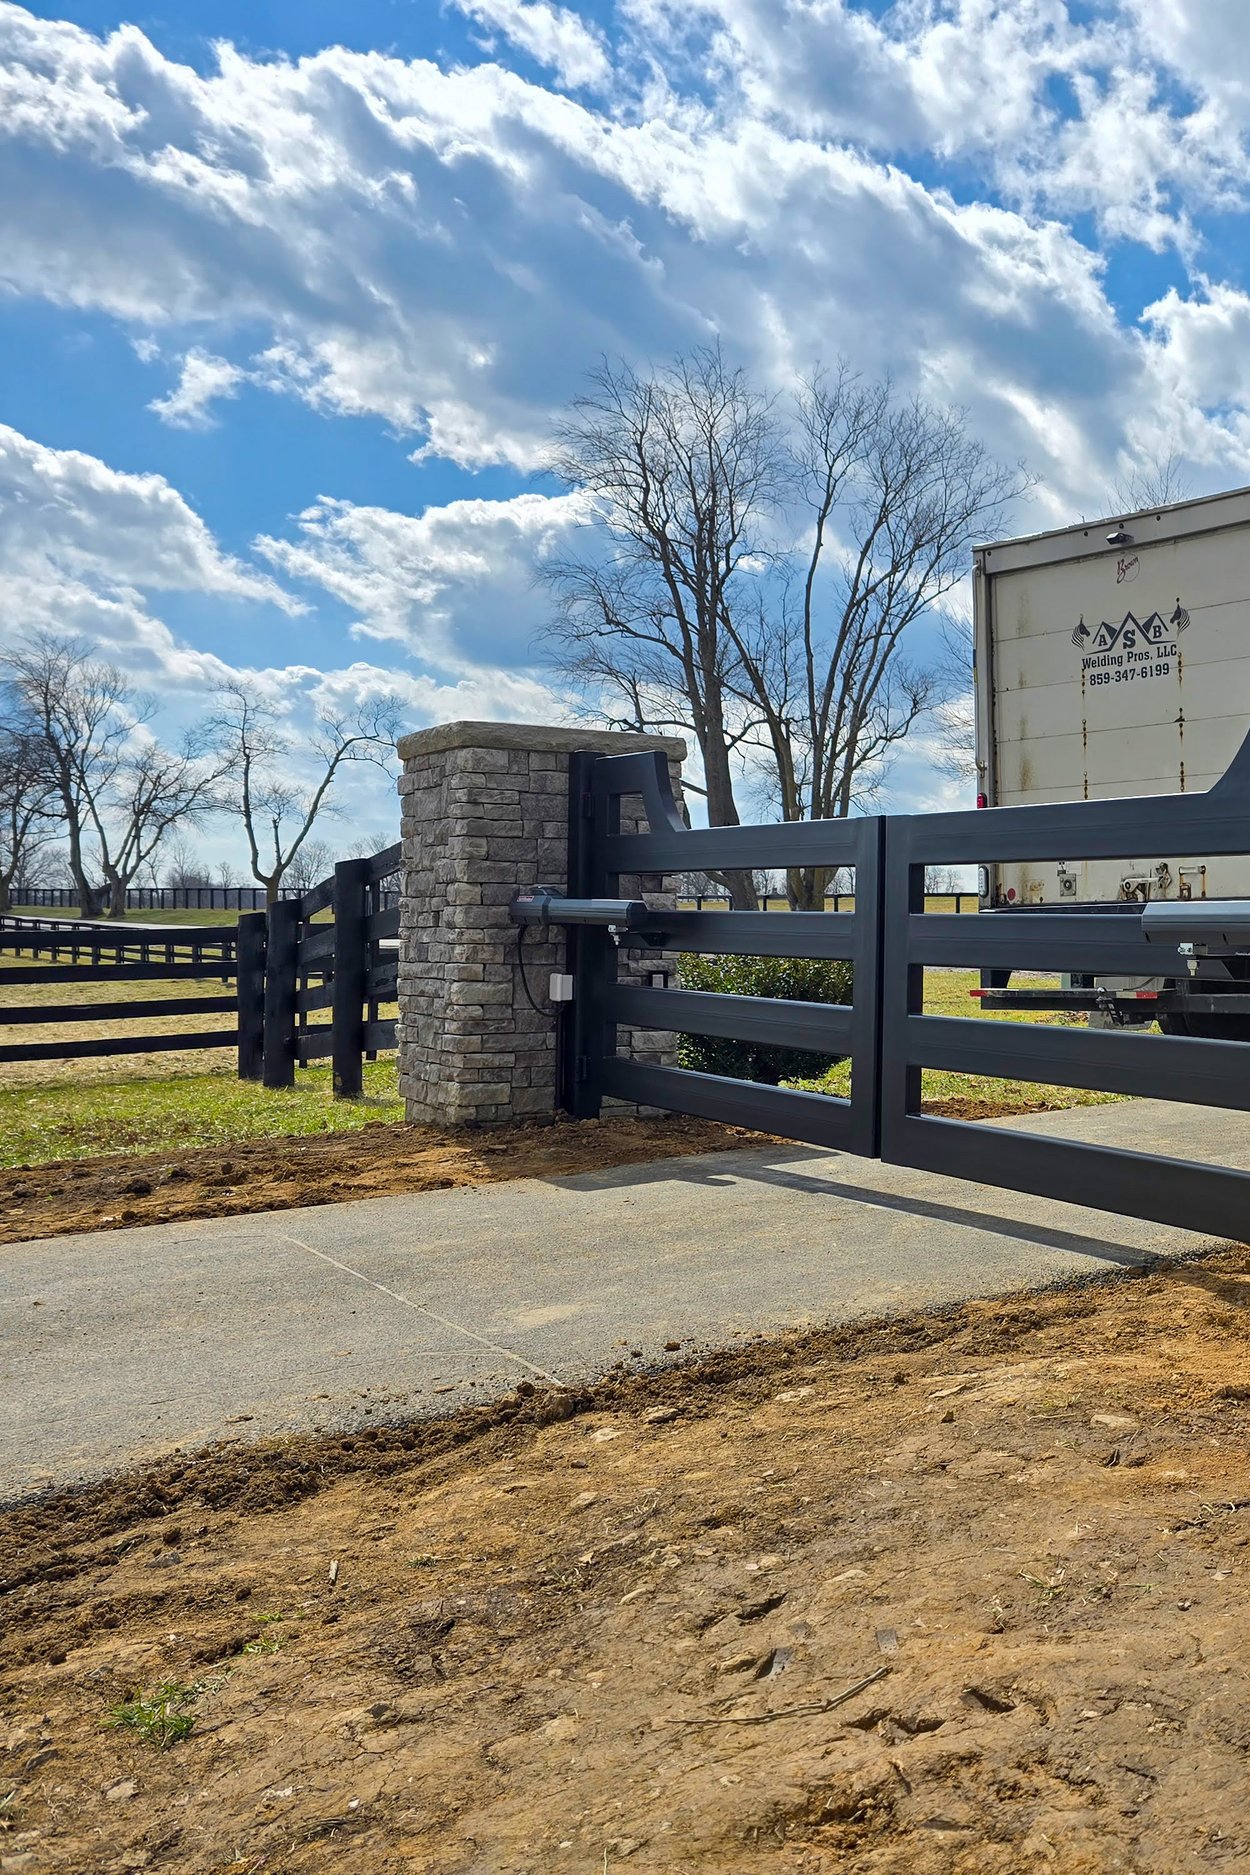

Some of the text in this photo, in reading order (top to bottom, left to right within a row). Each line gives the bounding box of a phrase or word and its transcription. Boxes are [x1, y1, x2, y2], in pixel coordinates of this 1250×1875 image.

[1116, 556, 1139, 584] Brown
[1082, 655, 1123, 669] Welding
[1157, 644, 1178, 658] LLC
[1089, 662, 1170, 686] 859-347-6199
